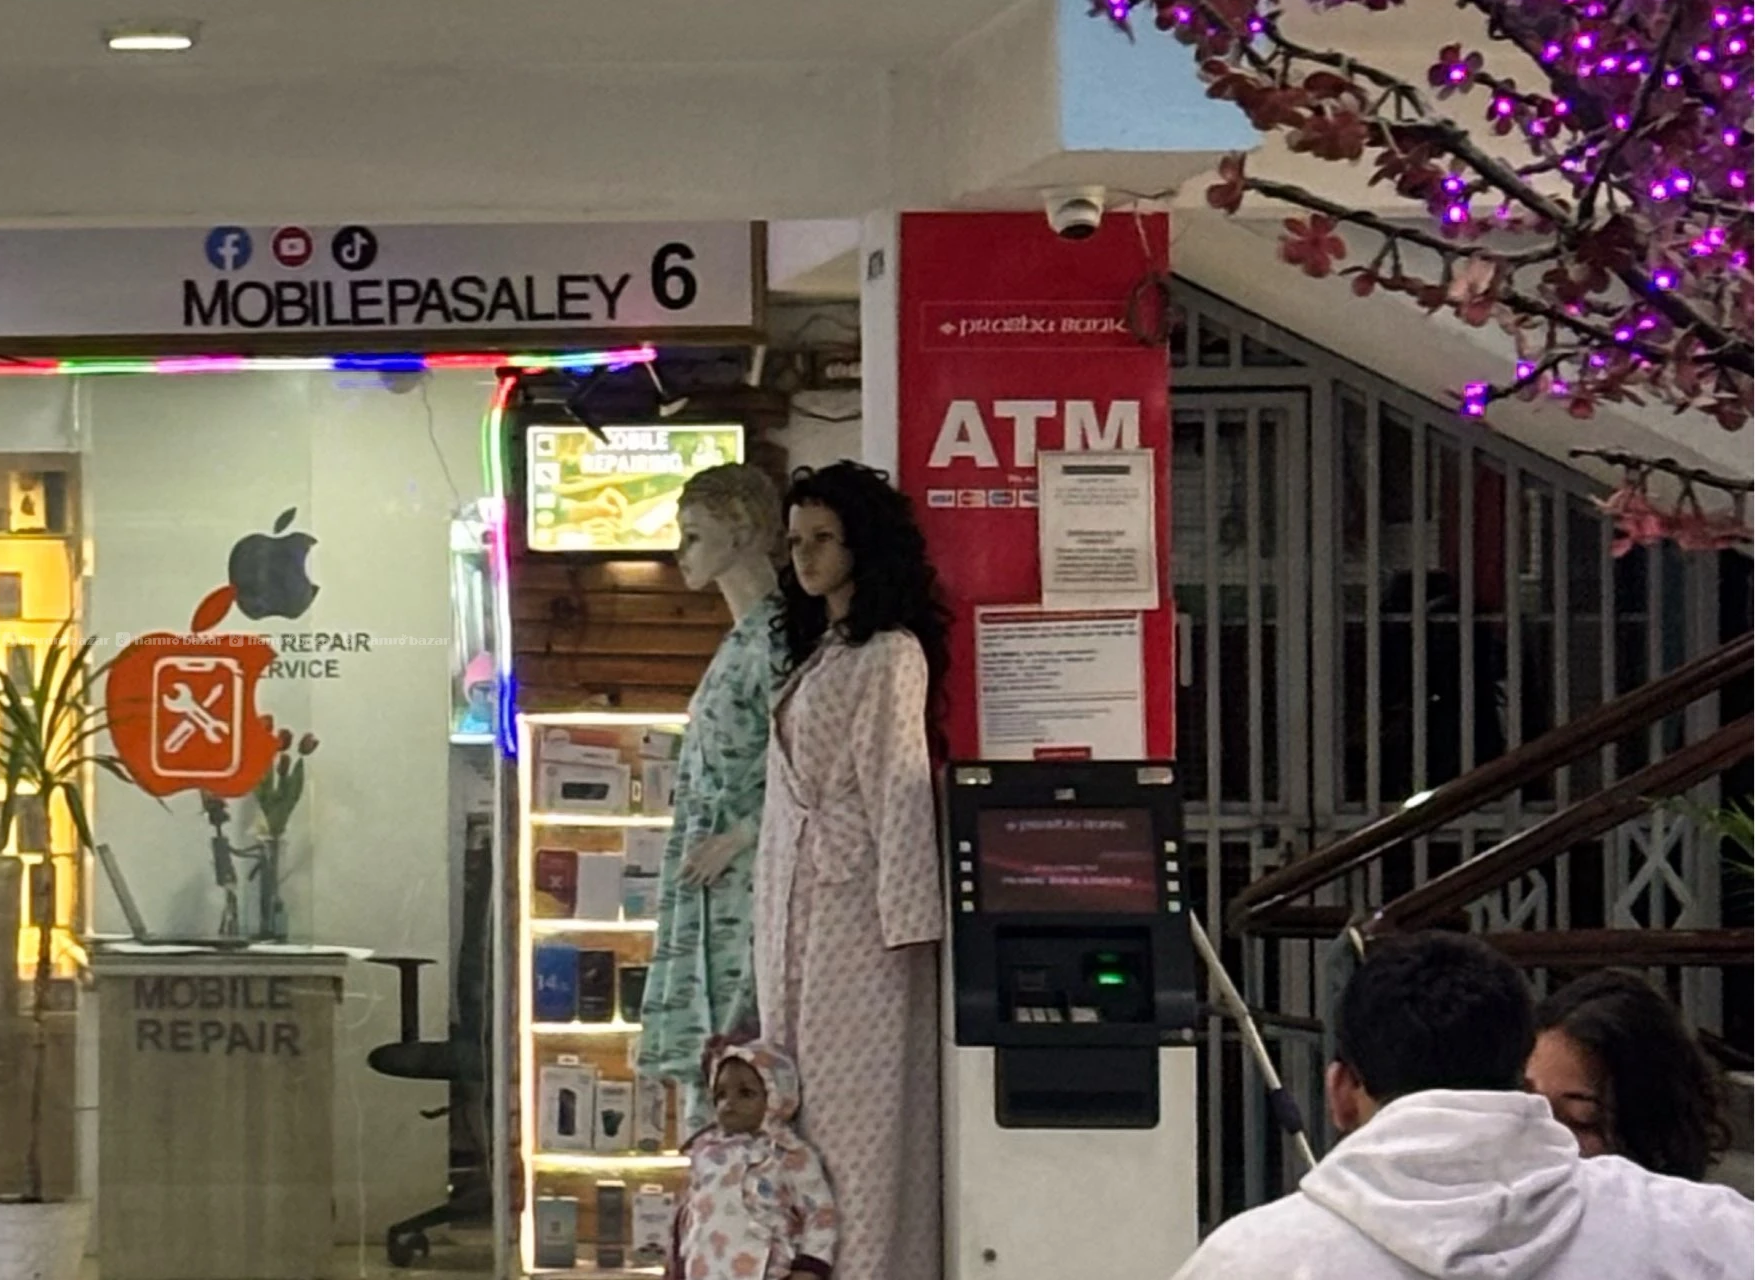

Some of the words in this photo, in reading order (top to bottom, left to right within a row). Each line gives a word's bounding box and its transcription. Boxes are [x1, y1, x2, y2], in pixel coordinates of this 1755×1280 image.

[182, 273, 631, 328] MOBILEPASALEY
[650, 242, 697, 310] 6
[927, 399, 1141, 468] ATM
[280, 631, 372, 653] REPAIR
[258, 658, 341, 679] RVICE
[134, 975, 294, 1010] MOBILE
[136, 1017, 302, 1057] REPAIR
